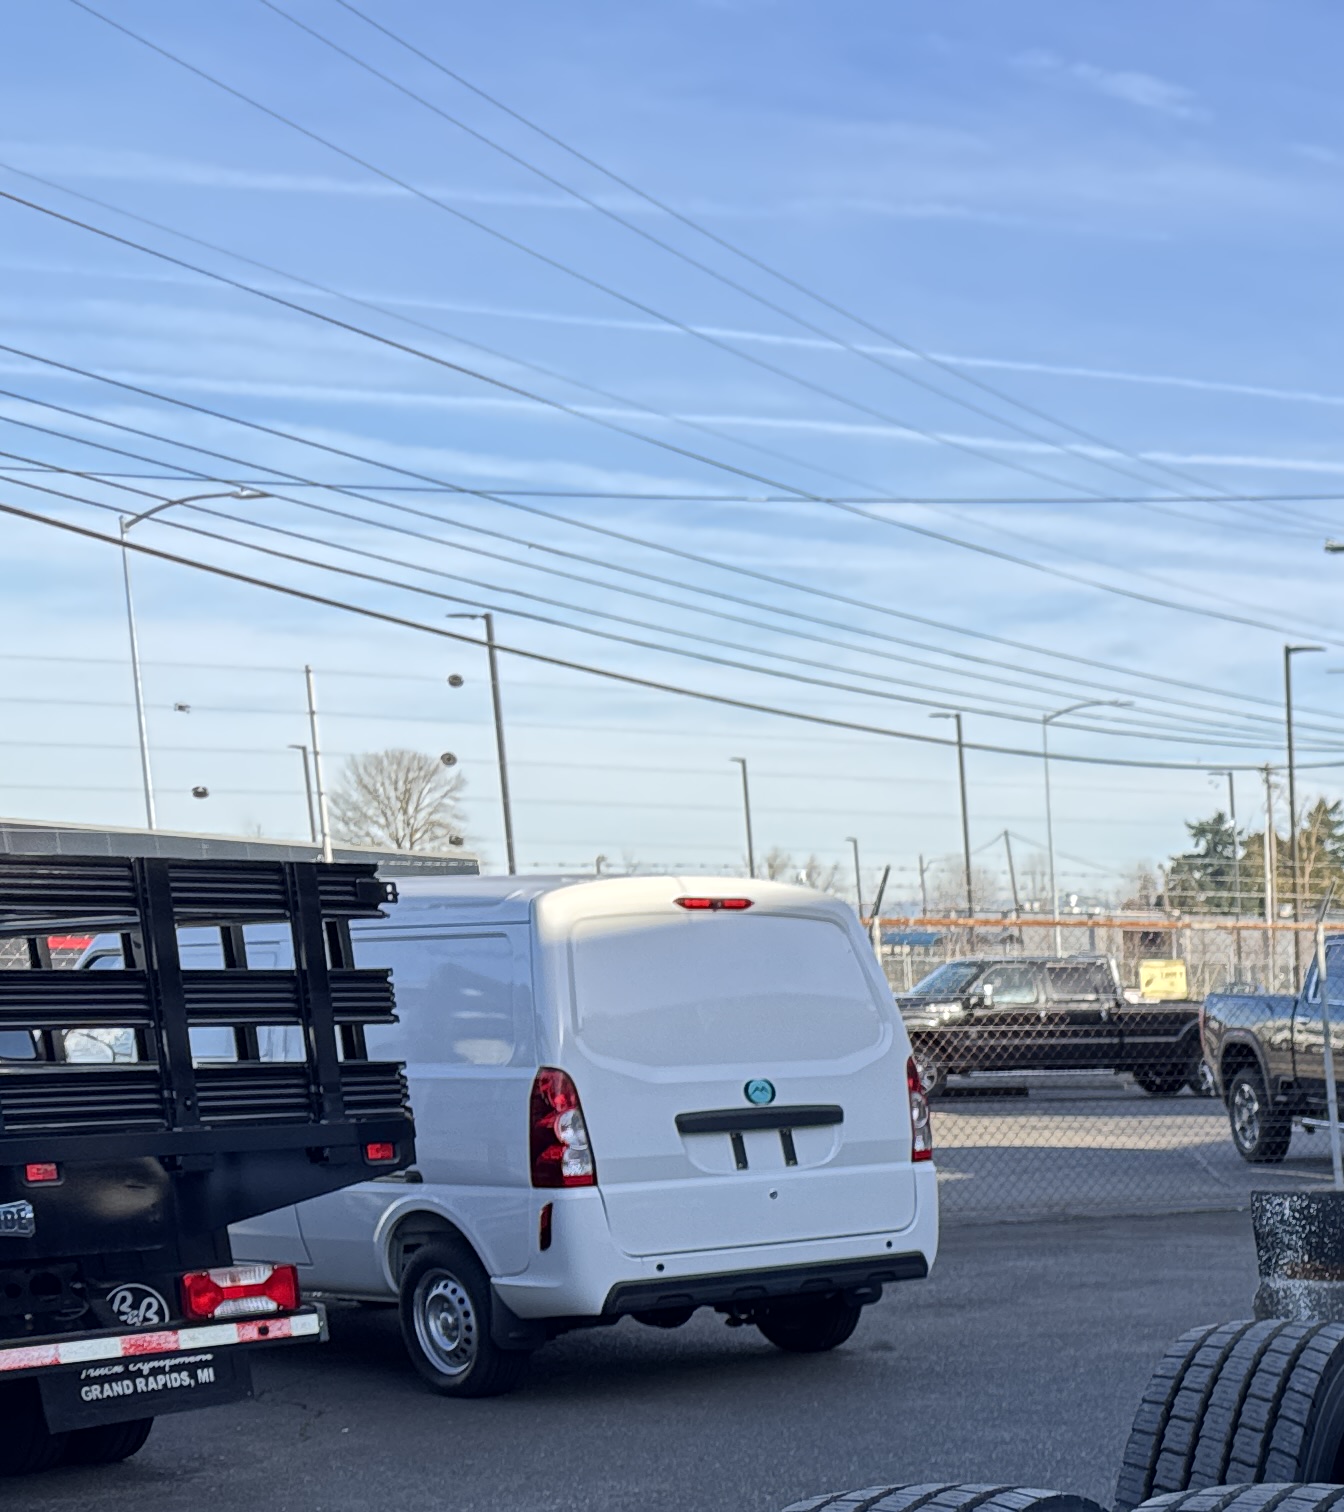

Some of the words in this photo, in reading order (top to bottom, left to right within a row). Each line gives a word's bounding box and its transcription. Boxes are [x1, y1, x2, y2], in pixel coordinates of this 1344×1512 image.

[80, 1379, 134, 1402] GRAND
[135, 1370, 196, 1393] RAPIDS,
[196, 1366, 216, 1385] MI
